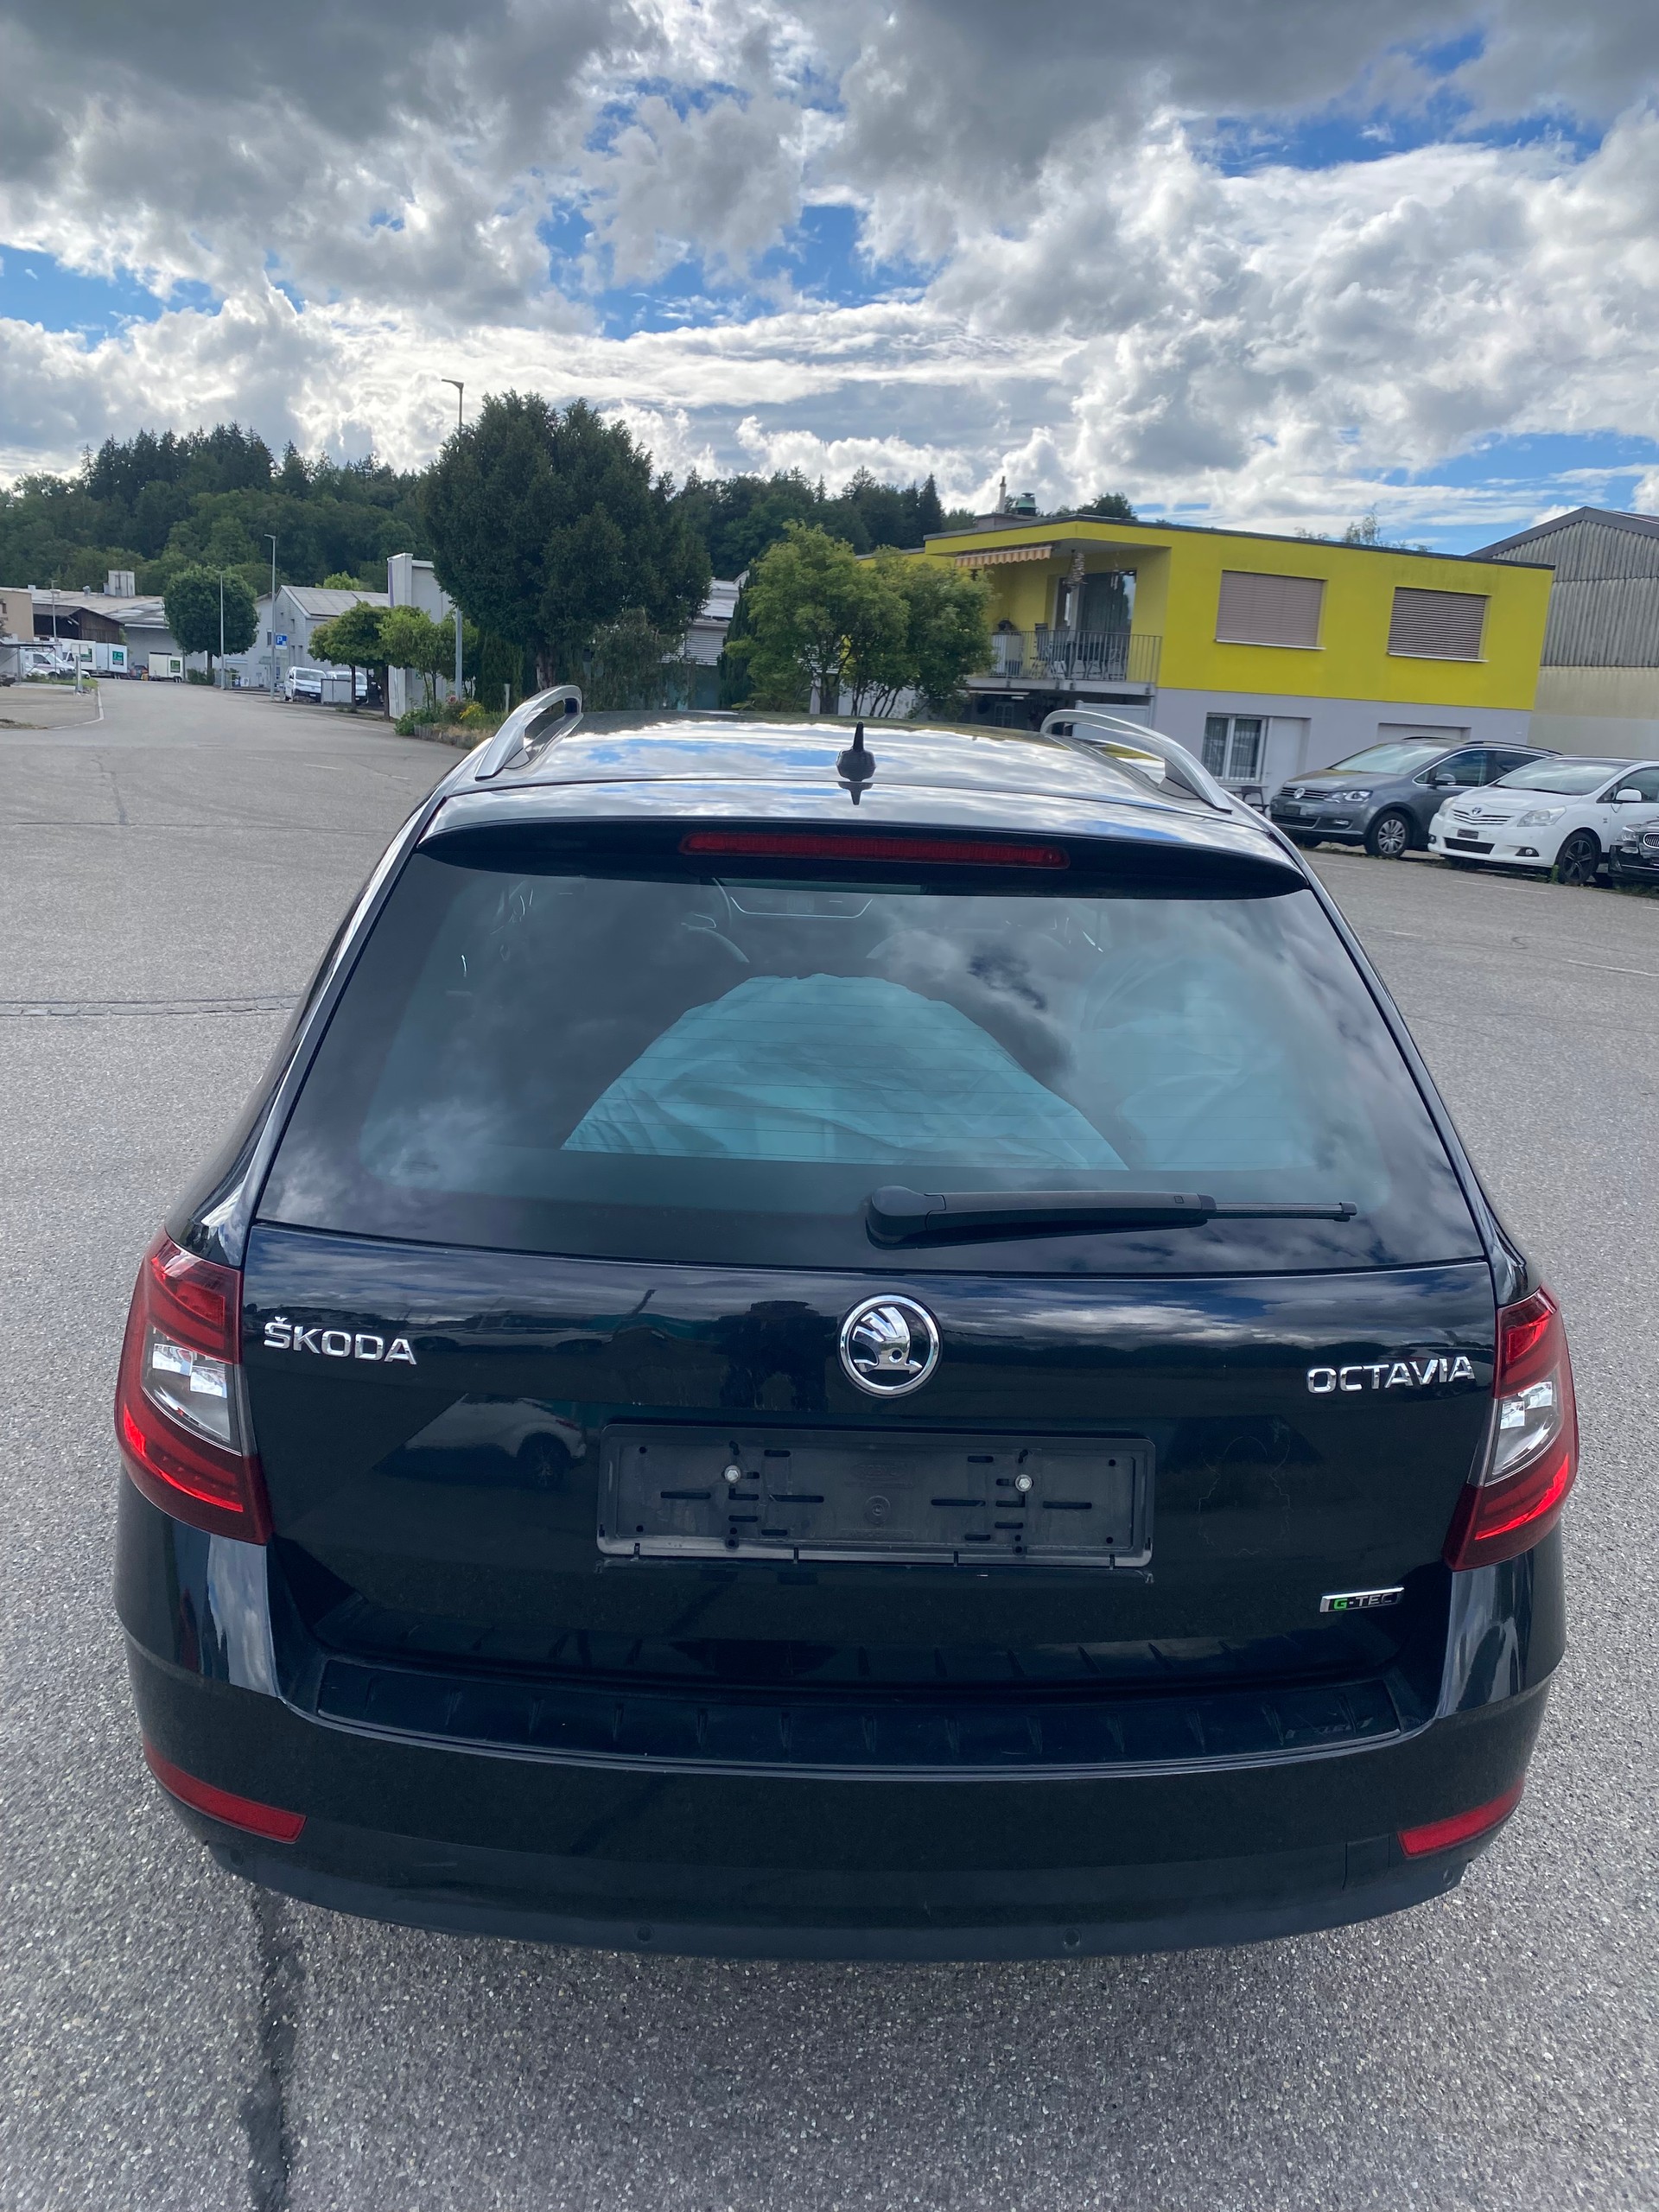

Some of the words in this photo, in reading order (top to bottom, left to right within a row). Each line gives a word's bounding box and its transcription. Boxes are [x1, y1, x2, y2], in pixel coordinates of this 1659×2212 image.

[263, 1316, 417, 1365] ŠKODA
[1306, 1355, 1476, 1394] OCTAVIA
[1332, 1592, 1395, 1611] G-TEC
